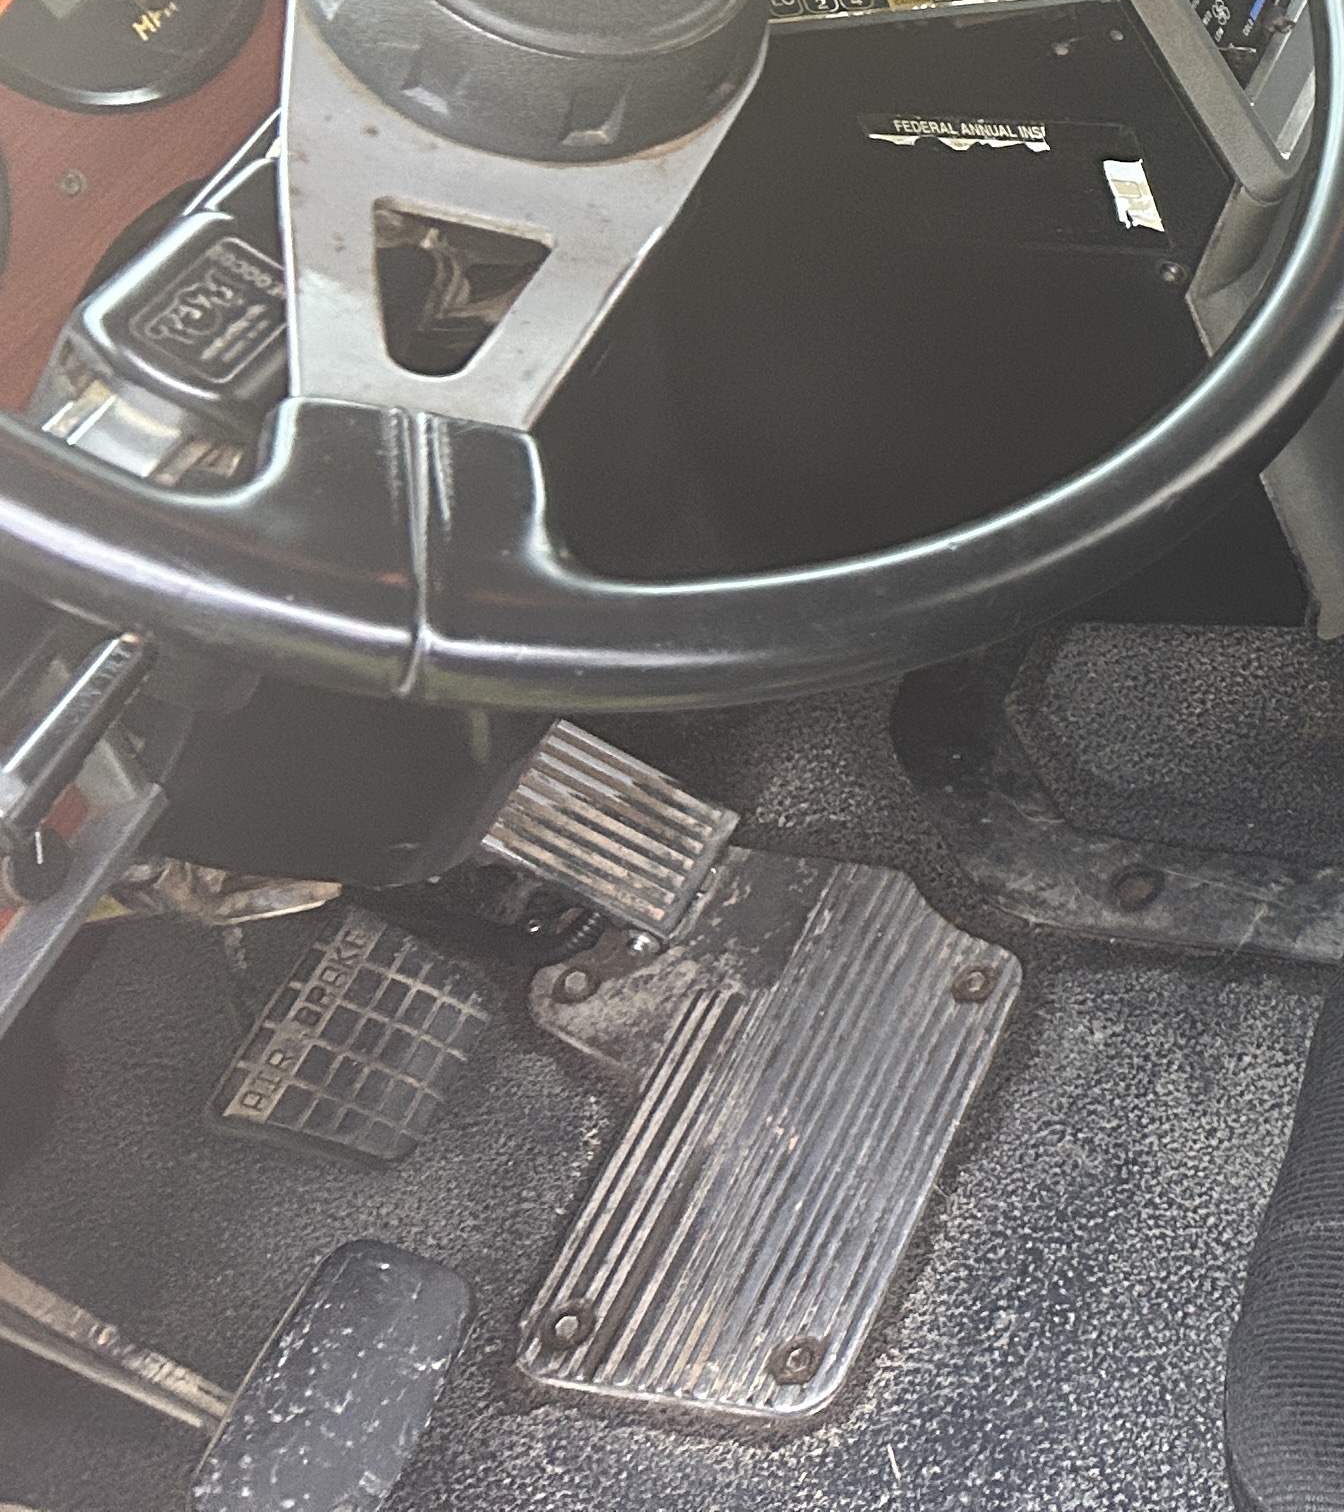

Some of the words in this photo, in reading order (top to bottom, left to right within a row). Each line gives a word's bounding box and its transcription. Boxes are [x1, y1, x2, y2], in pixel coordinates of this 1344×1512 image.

[893, 119, 960, 136] FEDERAL
[960, 122, 1014, 138] ANNUAL
[240, 1048, 294, 1112] AIR
